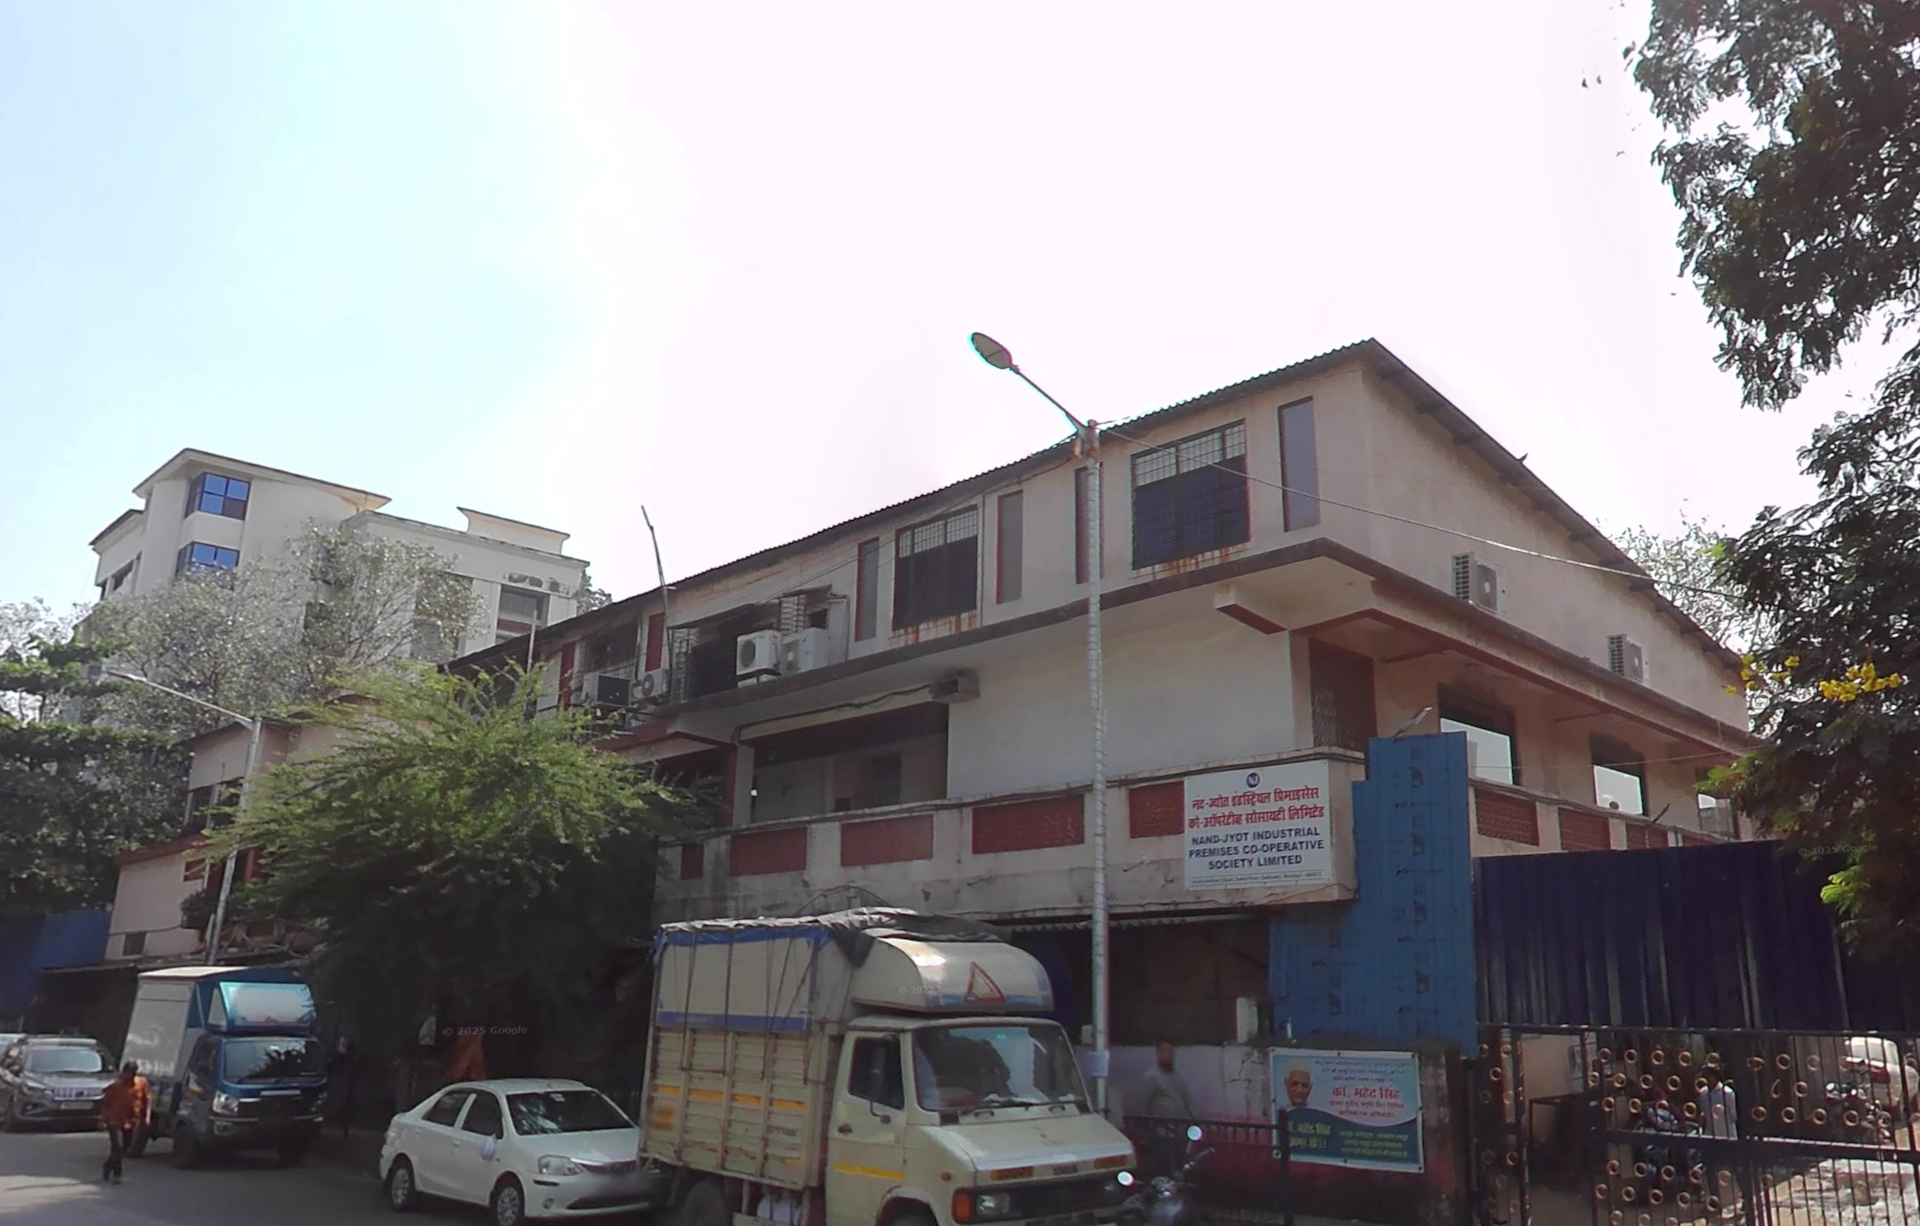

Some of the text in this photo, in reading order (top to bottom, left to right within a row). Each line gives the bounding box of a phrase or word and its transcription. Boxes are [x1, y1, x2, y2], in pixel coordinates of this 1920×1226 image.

[1245, 809, 1285, 824] सोसायटी
[1288, 804, 1325, 820] लिमिटेड
[1191, 826, 1320, 846] NAND-JYOT INDUSTRIAL
[1189, 839, 1325, 858] PREMISES CO-OPERATIVE
[1208, 854, 1303, 870] SOCIETY LIMITED
